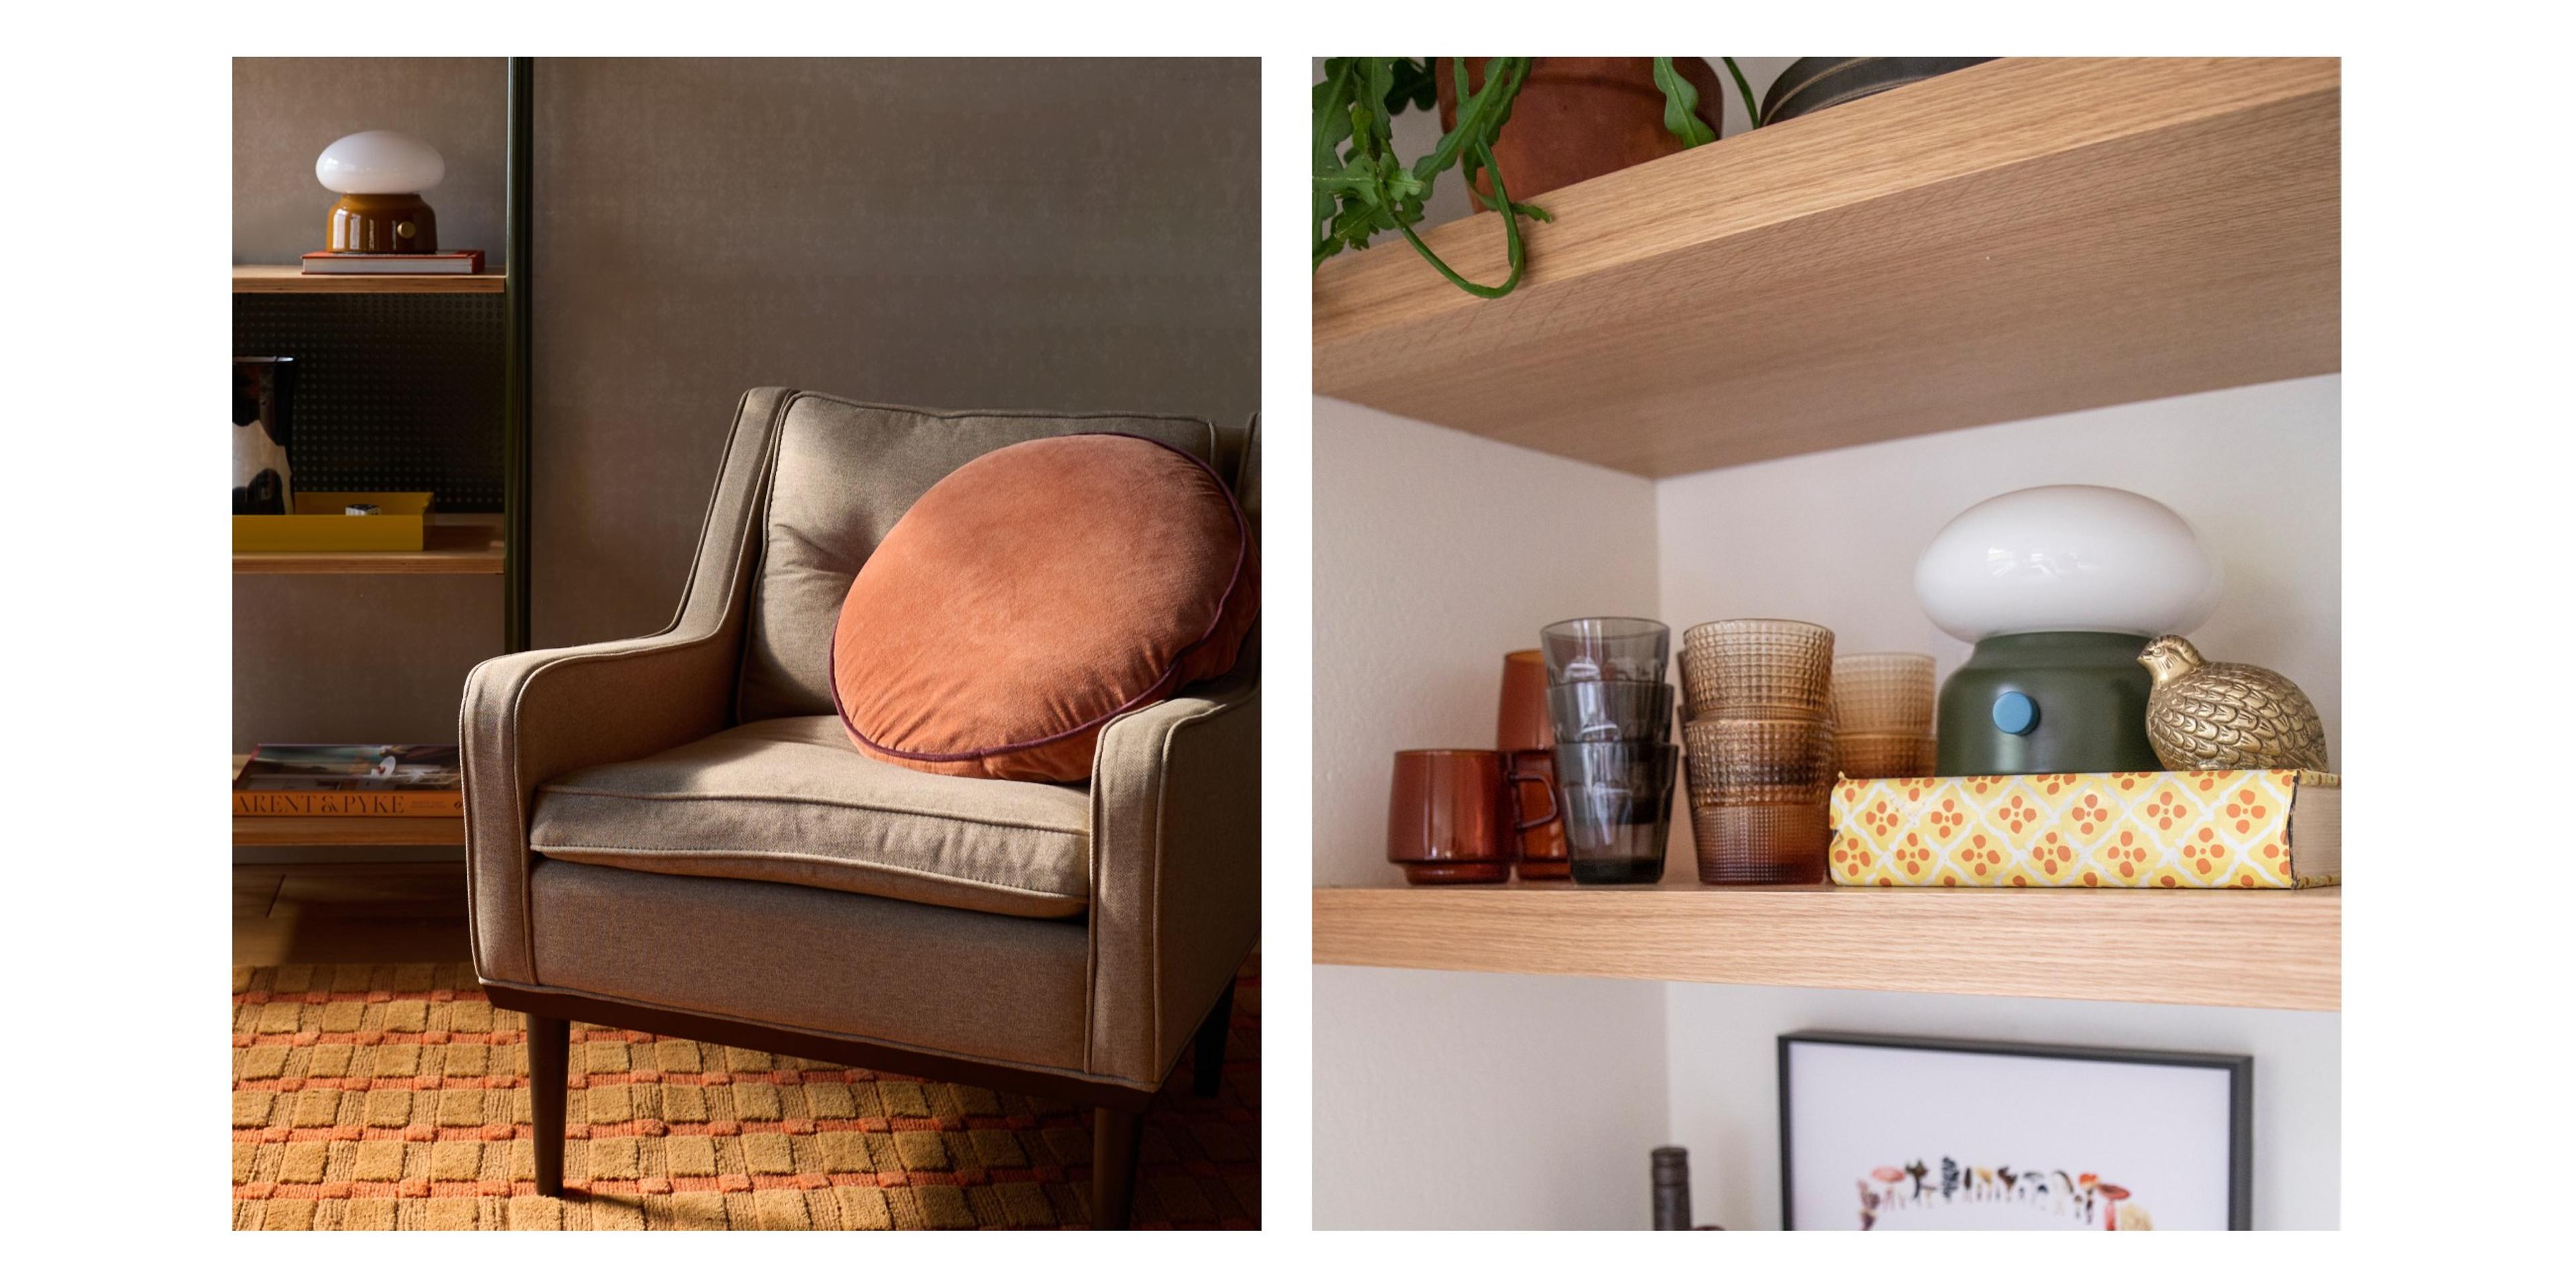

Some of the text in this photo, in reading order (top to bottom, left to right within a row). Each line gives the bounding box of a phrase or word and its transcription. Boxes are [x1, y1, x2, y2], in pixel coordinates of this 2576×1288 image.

[234, 795, 317, 812] ARENT
[321, 795, 339, 813] &
[343, 795, 405, 813] PYKE
